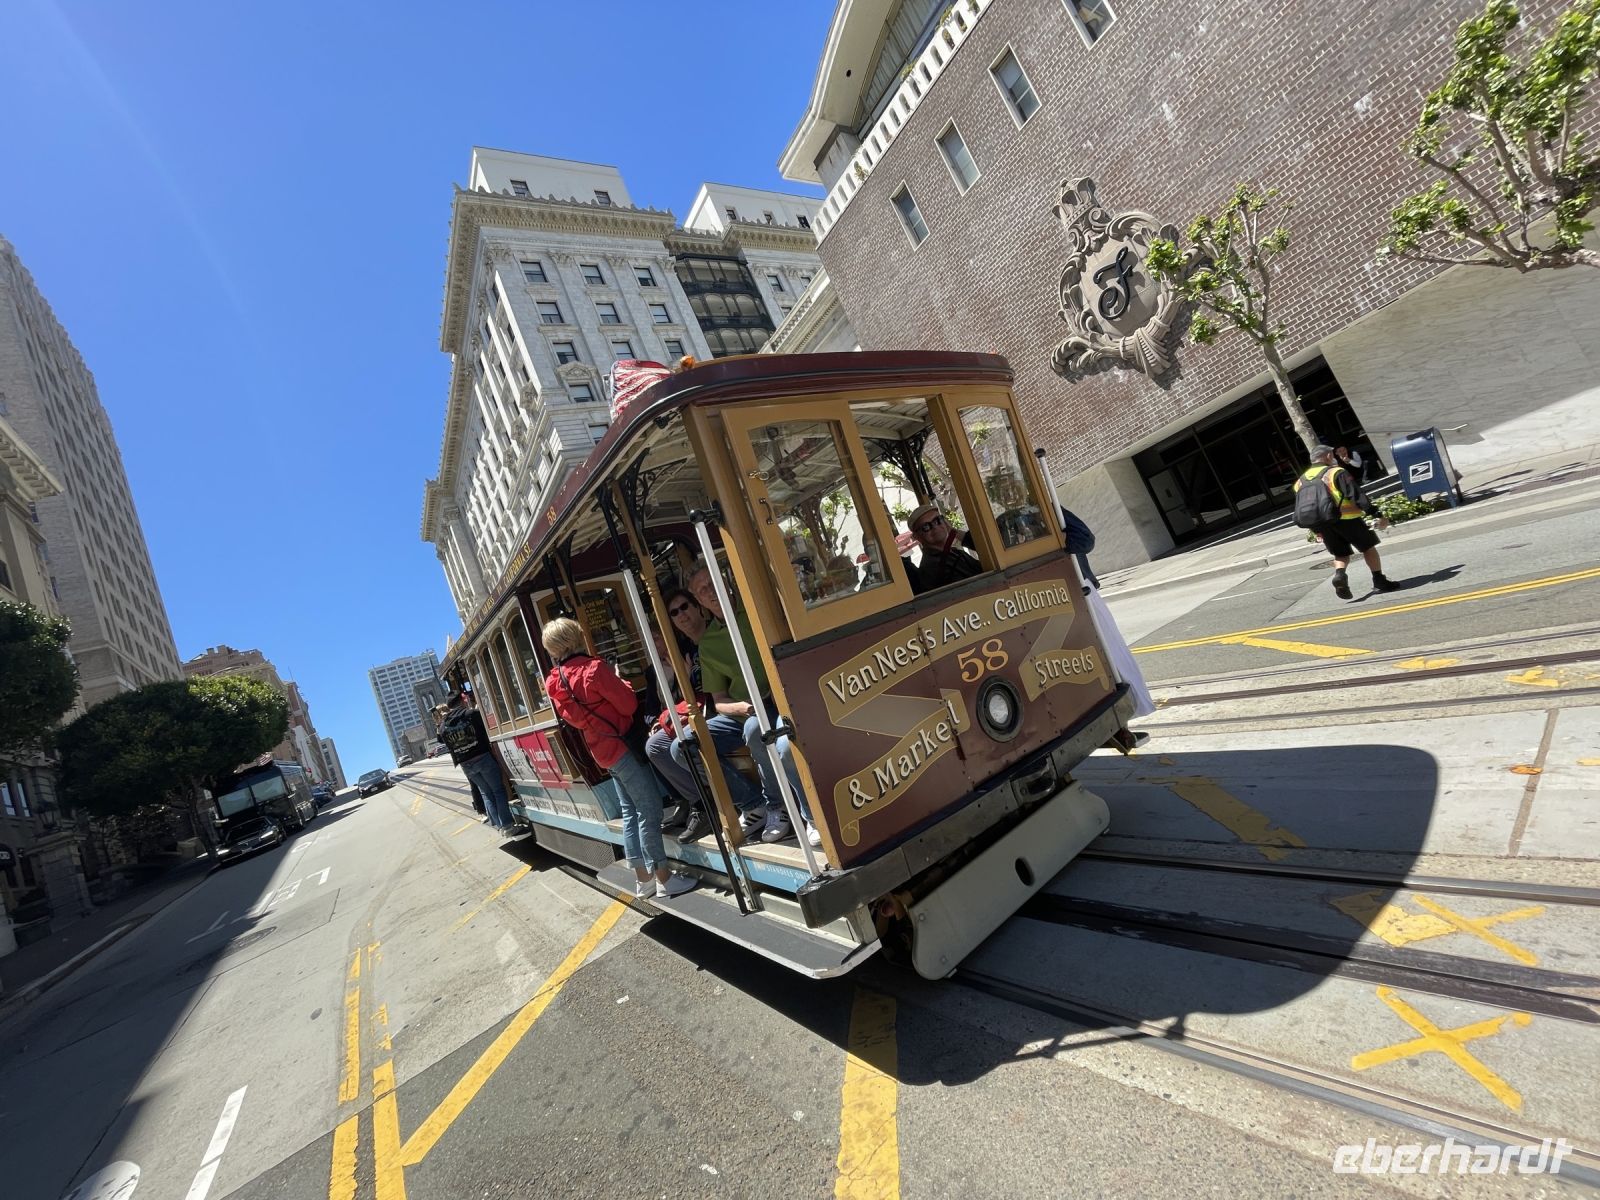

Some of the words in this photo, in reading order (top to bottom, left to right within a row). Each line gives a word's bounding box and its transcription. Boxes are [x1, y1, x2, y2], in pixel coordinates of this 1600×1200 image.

[826, 671, 879, 704] Van
[994, 584, 1070, 621] California
[957, 638, 1009, 682] 58
[1034, 651, 1094, 685] Streets
[849, 778, 874, 808] &
[872, 700, 960, 795] Market
